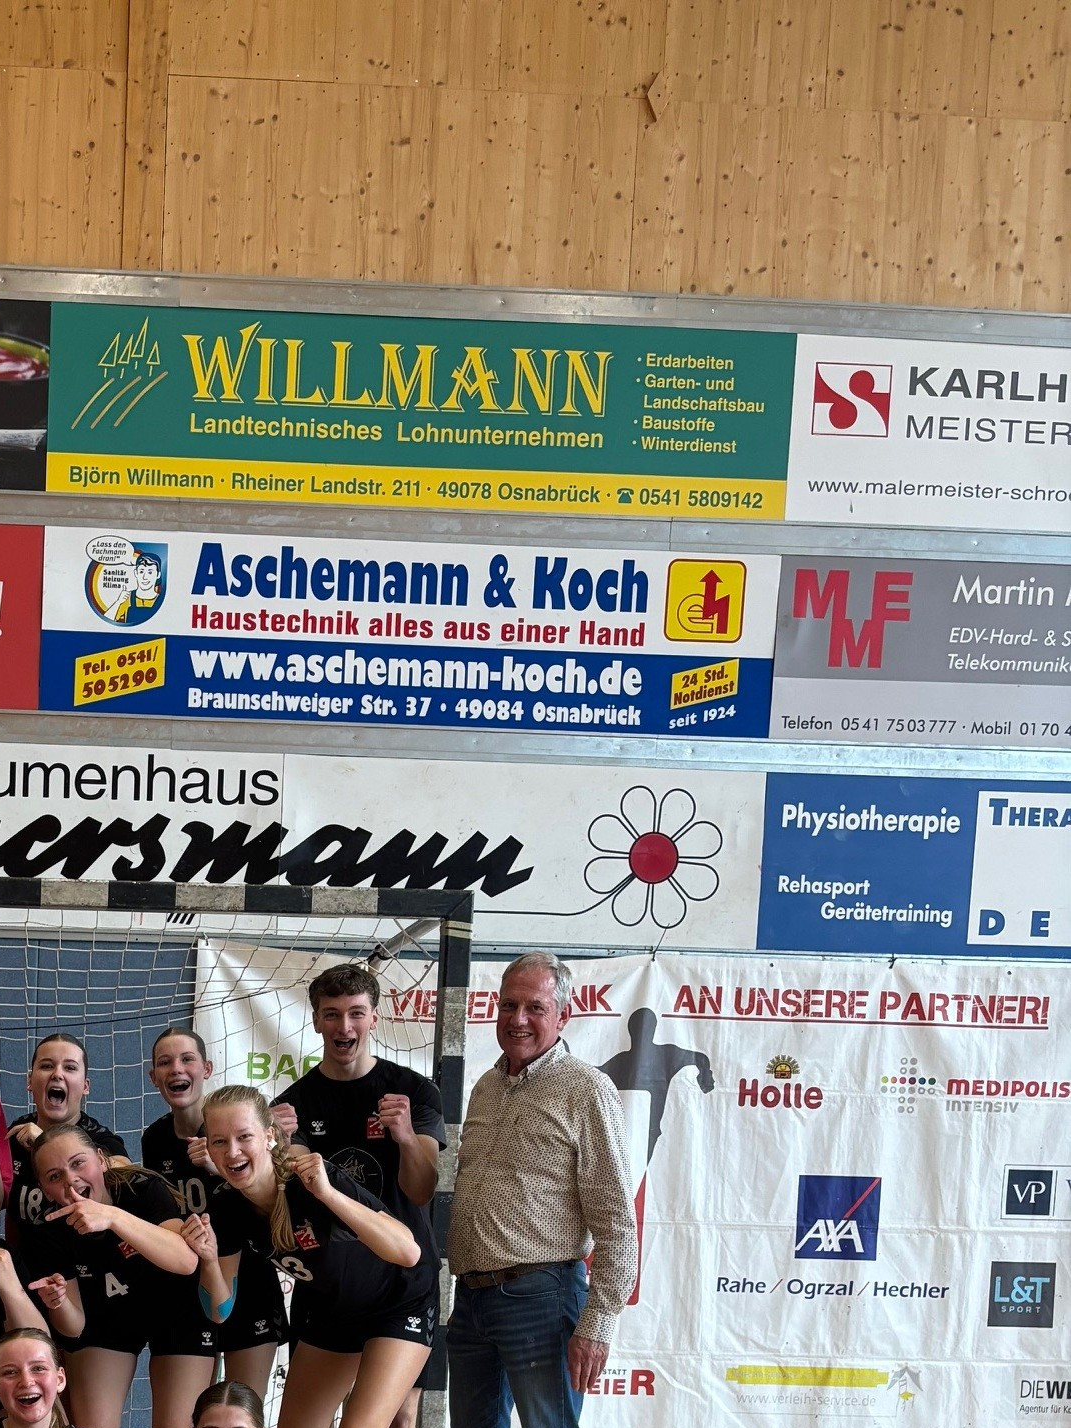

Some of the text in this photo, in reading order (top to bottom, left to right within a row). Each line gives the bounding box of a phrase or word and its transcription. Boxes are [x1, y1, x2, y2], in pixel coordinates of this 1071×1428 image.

[181, 320, 615, 418] WILLMANN
[645, 353, 734, 371] Erdarbeiten
[644, 374, 735, 391] Garten- und
[643, 395, 765, 414] Landschaftsbau
[189, 412, 604, 448] Landtechnisches Lohnunternehmen
[641, 416, 715, 432] Baustoffe
[906, 415, 1071, 446] MEISTER
[640, 435, 737, 454] Winterdienst
[69, 465, 763, 510] Björn Willmann Rheiner Landstr. 211 49078 Osnabrück 0541 5809142
[191, 542, 649, 614] Aschemann & Koch
[953, 575, 1054, 606] Martin
[191, 604, 645, 647] Haustechnik alles aus einer Hand
[949, 627, 1038, 646] EDV-Hard-
[1044, 631, 1056, 647] &
[83, 646, 158, 676] Tel. 0541/
[189, 649, 642, 696] www.aschemann-koch.de
[682, 667, 729, 687] 24 Std.
[674, 681, 735, 705] Notdienst
[188, 688, 641, 726] Braunschweiger Str. 37 49084 Osnabrück
[669, 705, 736, 729] seit 1924
[781, 716, 832, 730] Telefon
[970, 721, 1011, 735] Mobil
[782, 802, 960, 839] Physiotherapie
[778, 874, 870, 899] Rehasport
[821, 901, 952, 928] Gerätetraining
[674, 984, 1049, 1025] AN UNSERE PARTNER!
[738, 1078, 823, 1110] Holle
[178, 1178, 206, 1214] 10
[1013, 1181, 1046, 1203] VP
[794, 1218, 865, 1253] AXA
[105, 1272, 129, 1297] 4
[716, 1277, 950, 1300] Rahe Ogrzal Hechler
[994, 1276, 1050, 1303] L&T
[737, 1392, 876, 1407] www.verleih-service.de
[1020, 1404, 1061, 1414] Agentur für
